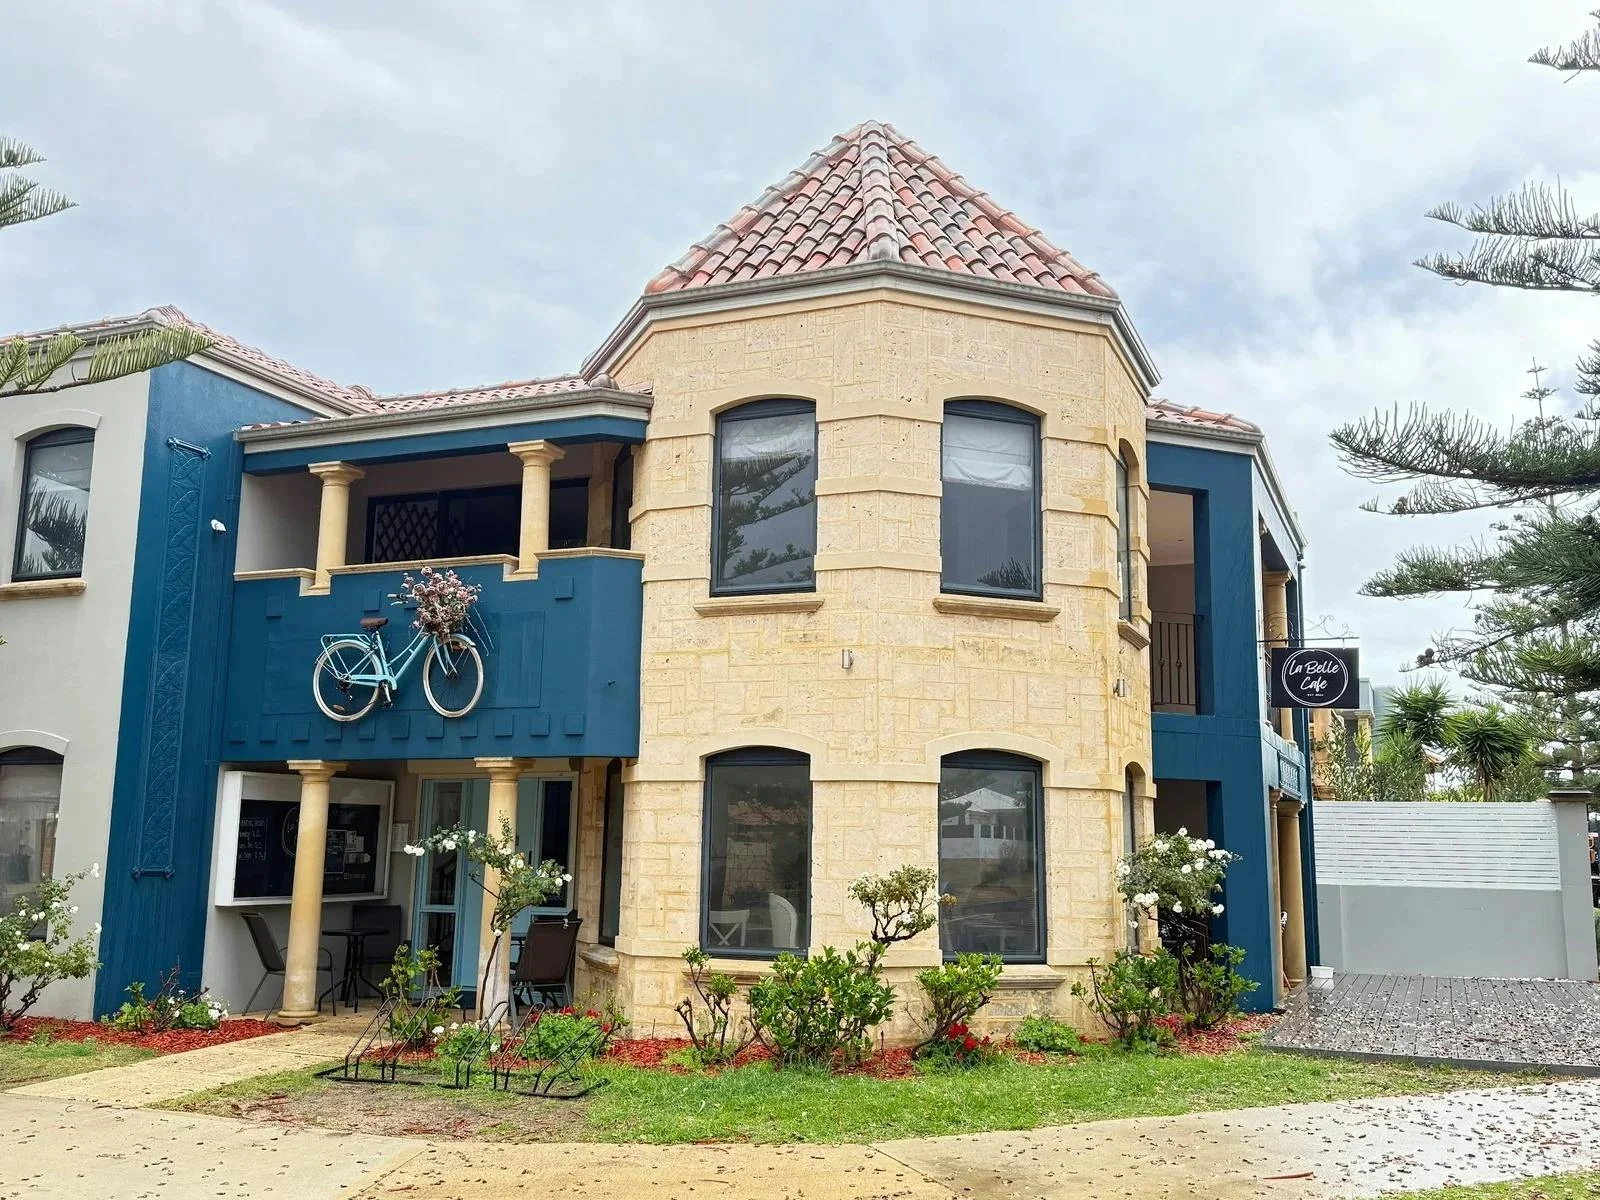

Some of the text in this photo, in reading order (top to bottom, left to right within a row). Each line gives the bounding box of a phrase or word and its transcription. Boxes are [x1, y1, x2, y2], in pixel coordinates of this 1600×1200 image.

[1289, 660, 1340, 675] La Belle
[1300, 676, 1328, 692] Cafe
